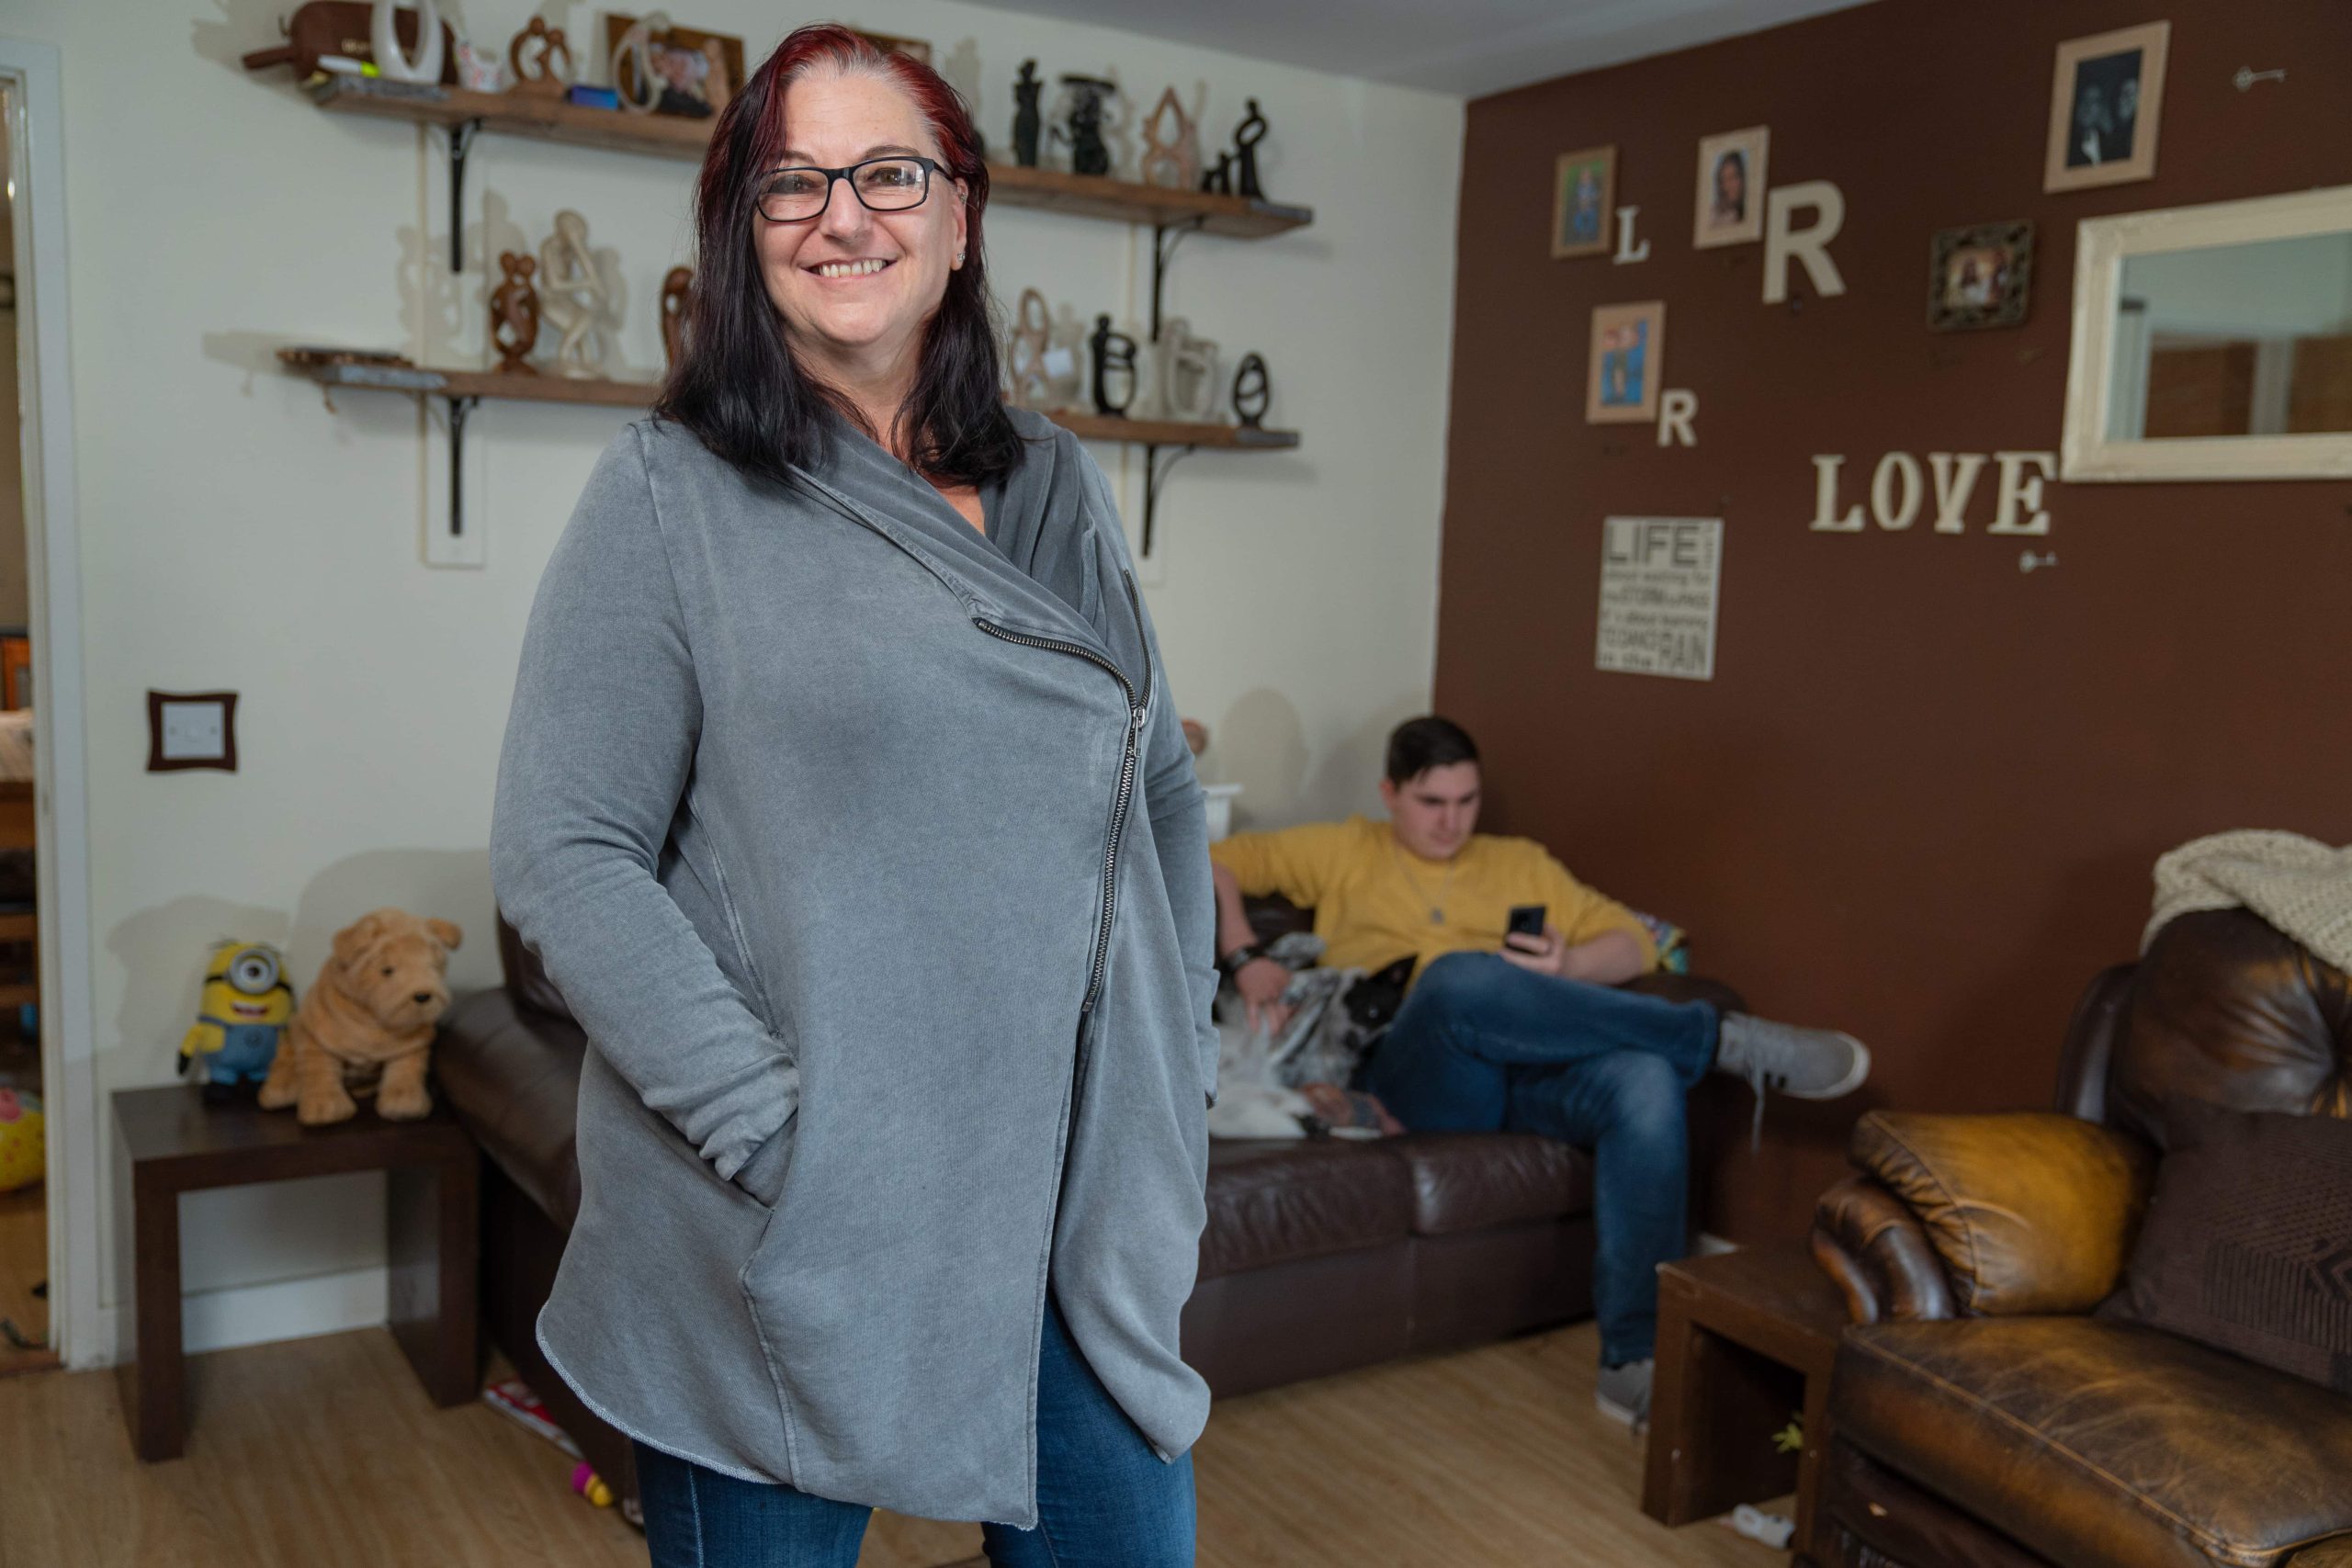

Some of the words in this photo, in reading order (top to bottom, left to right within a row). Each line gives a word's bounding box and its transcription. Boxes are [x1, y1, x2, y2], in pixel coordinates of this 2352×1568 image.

[1613, 205, 1651, 265] L
[1762, 180, 1846, 304] R
[1657, 388, 1699, 446] R
[1808, 450, 2058, 536] LOVE
[1603, 525, 1700, 565] LIFE
